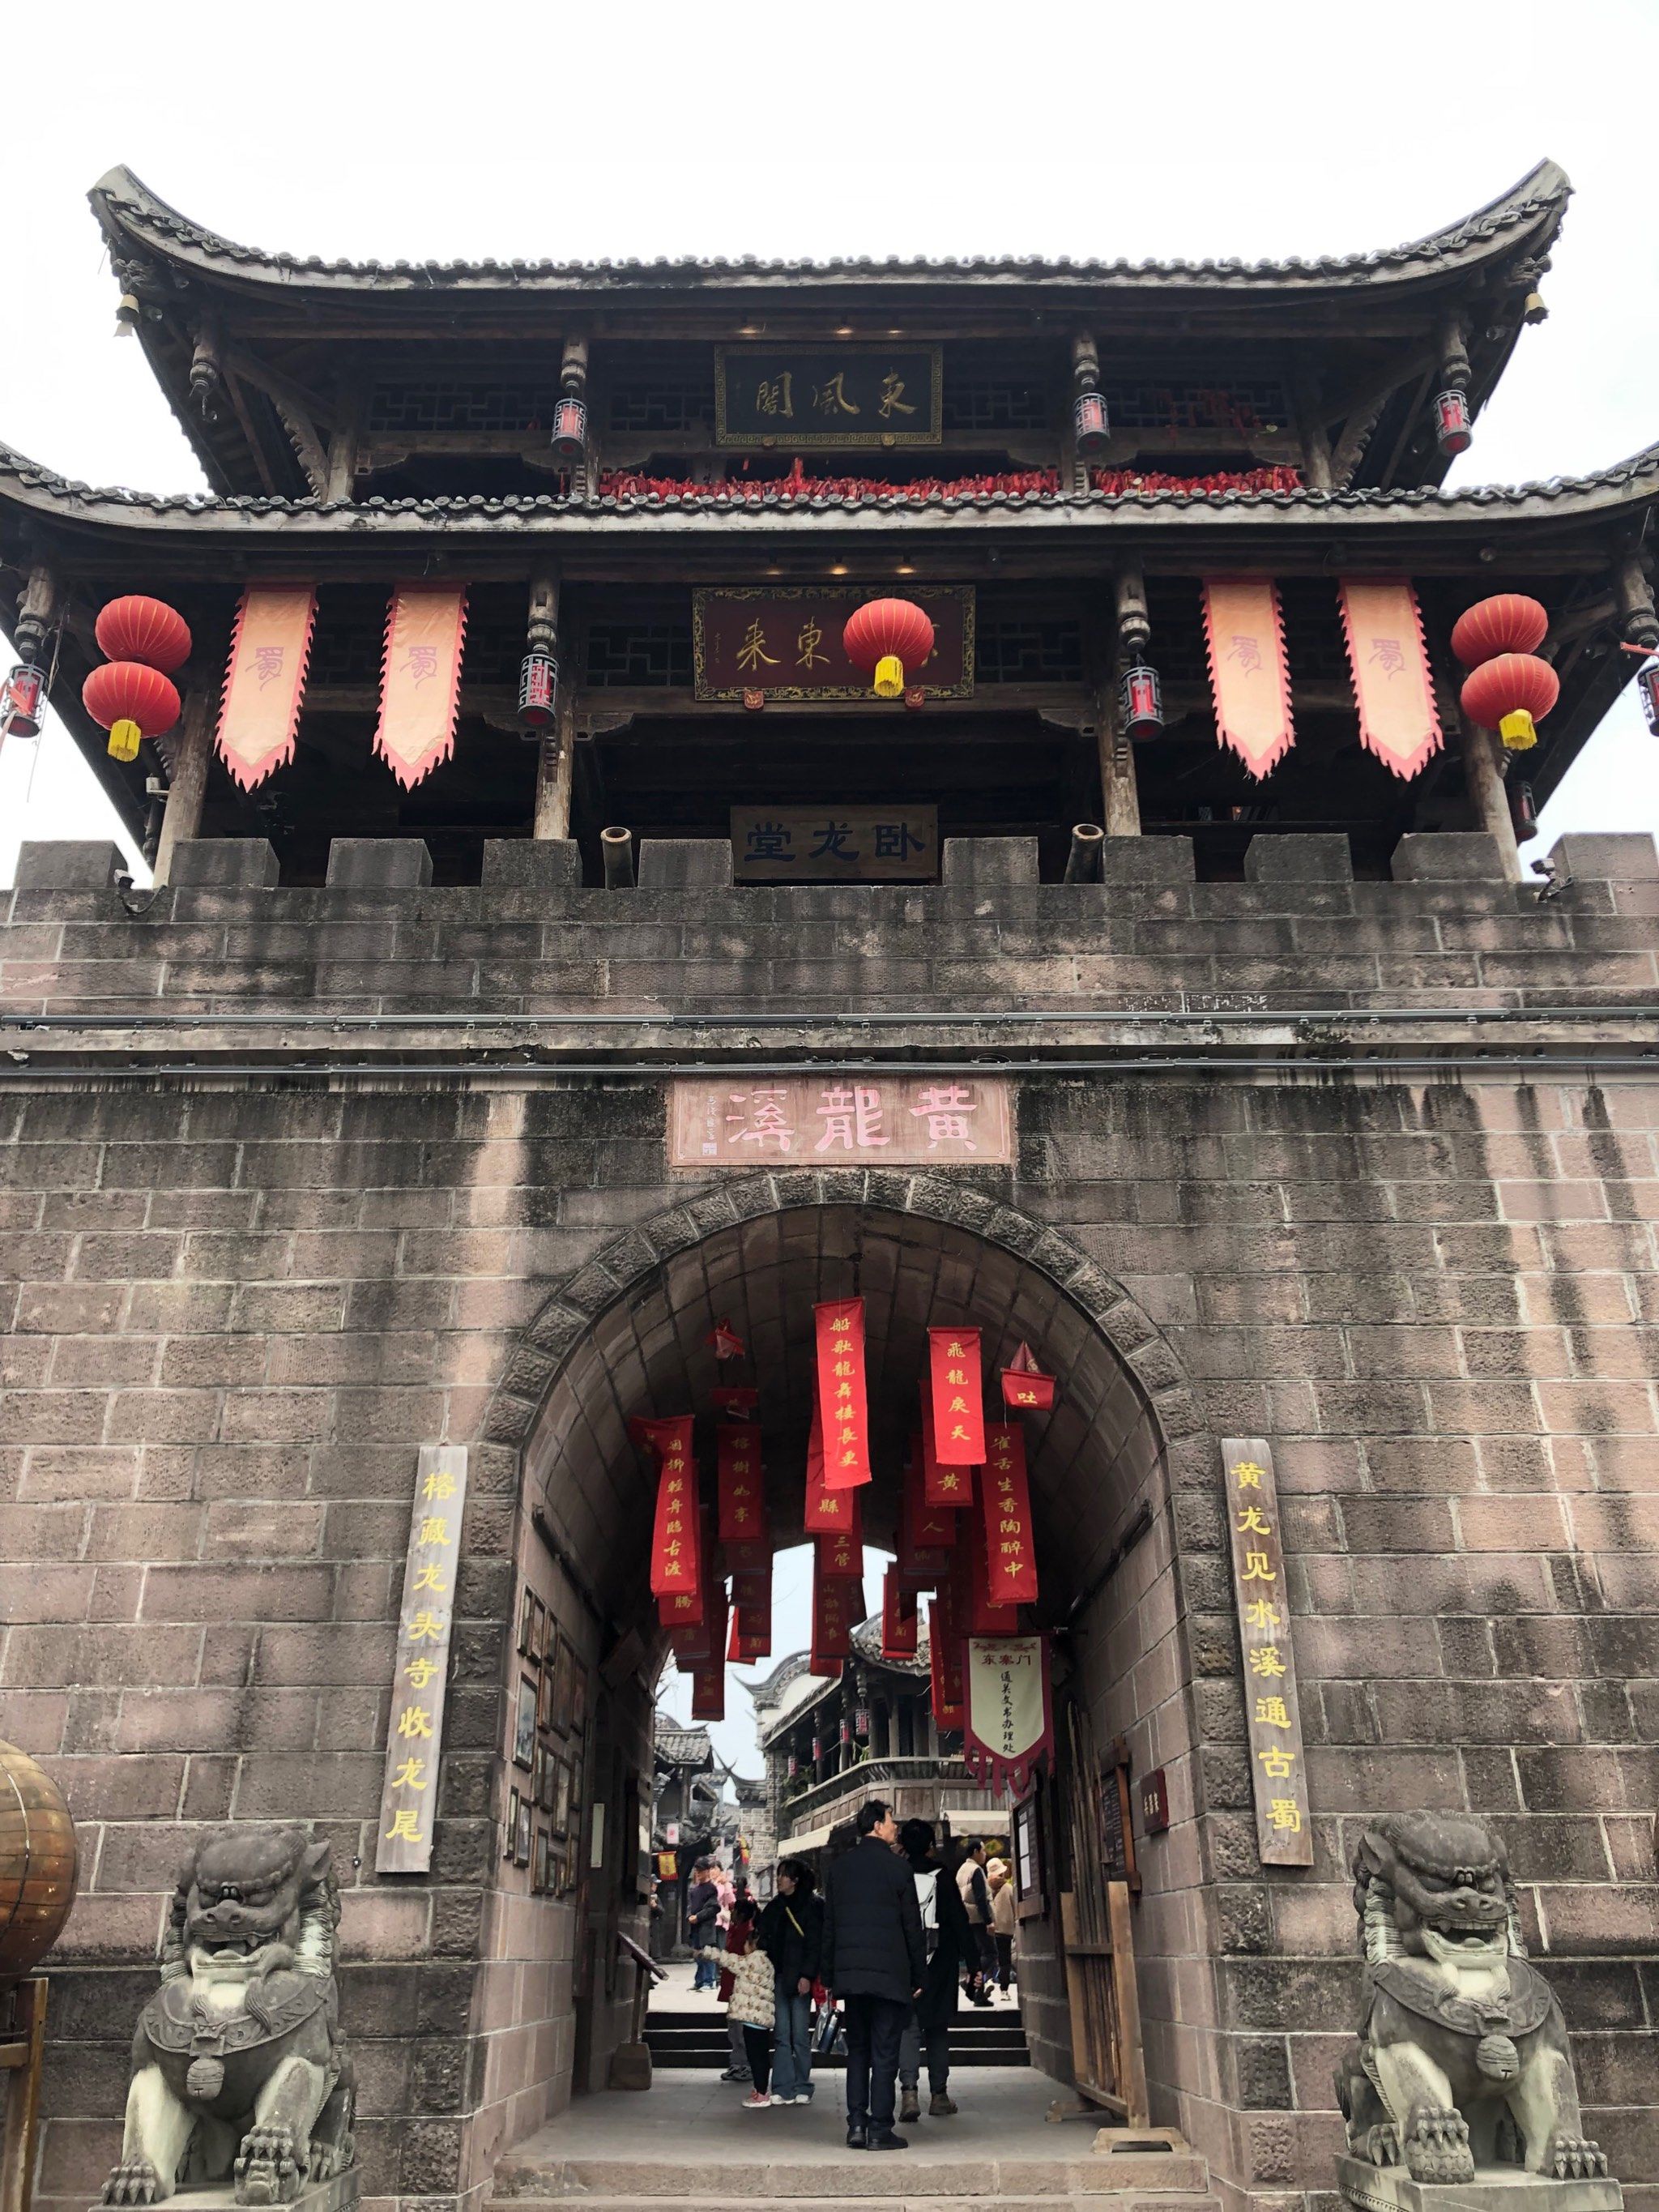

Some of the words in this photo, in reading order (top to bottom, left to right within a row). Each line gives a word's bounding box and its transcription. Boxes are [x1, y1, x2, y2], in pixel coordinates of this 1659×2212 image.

[743, 821, 926, 863] 卧龙堂
[990, 1435, 1025, 1578] 雀舌生香陶醉中
[385, 1471, 458, 1843] 榕藏龙头寺收龙尾
[1000, 1670, 1016, 1753] 通关文书办理处
[1230, 1461, 1301, 1833] 黄龙见水溪通古蜀
